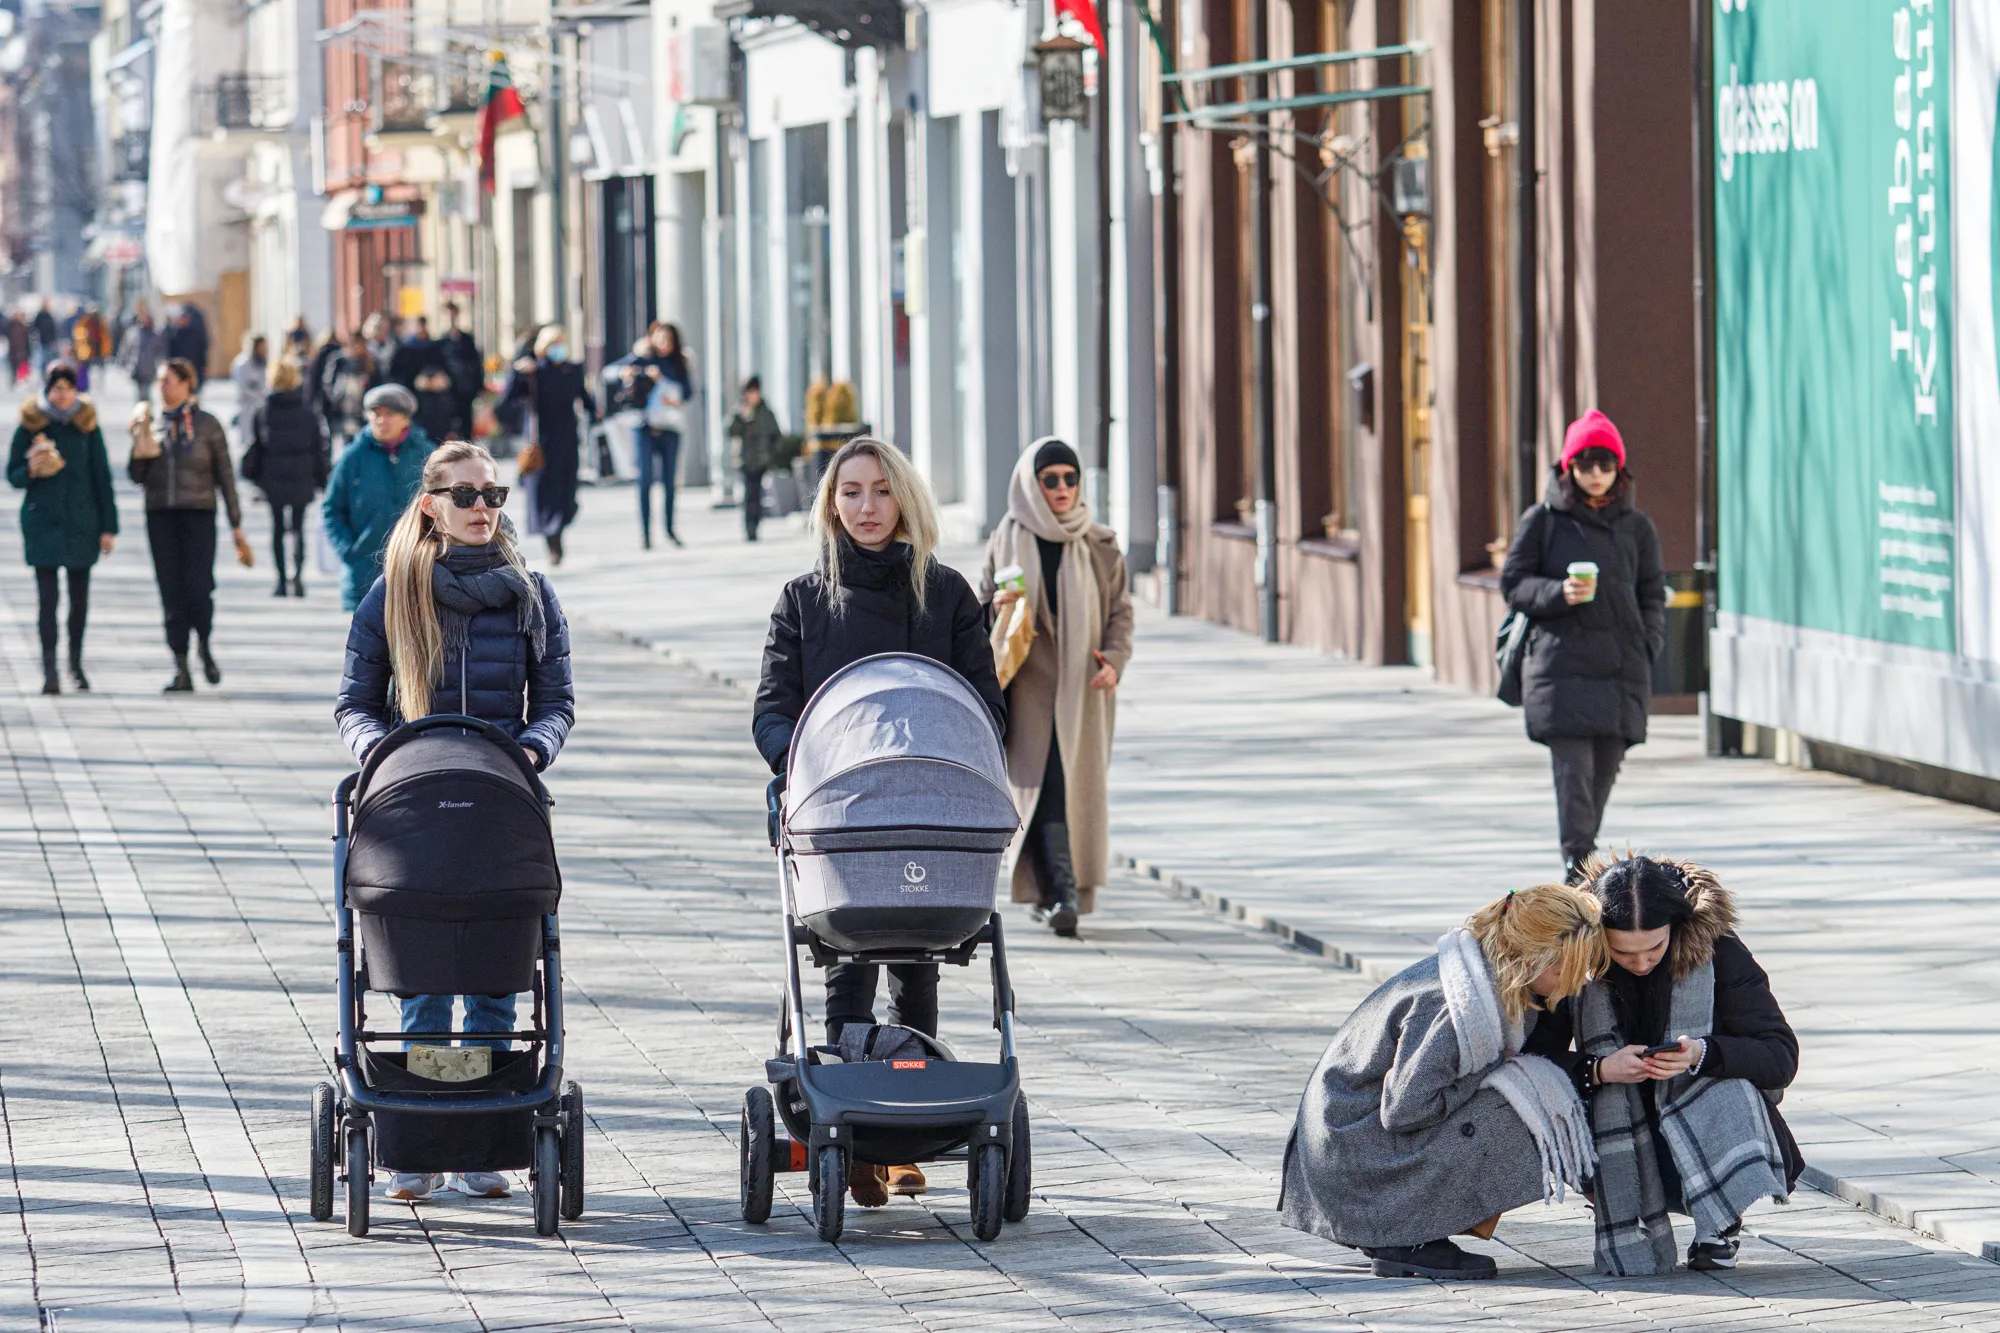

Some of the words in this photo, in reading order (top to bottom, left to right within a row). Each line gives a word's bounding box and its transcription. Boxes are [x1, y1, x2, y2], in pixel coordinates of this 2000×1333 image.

[1719, 63, 1789, 182] glasses
[1791, 78, 1818, 150] on
[1888, 7, 1913, 362] Labas
[438, 801, 474, 809] X-lander
[900, 884, 930, 893] STOKKE
[894, 1061, 923, 1069] STOKKE
